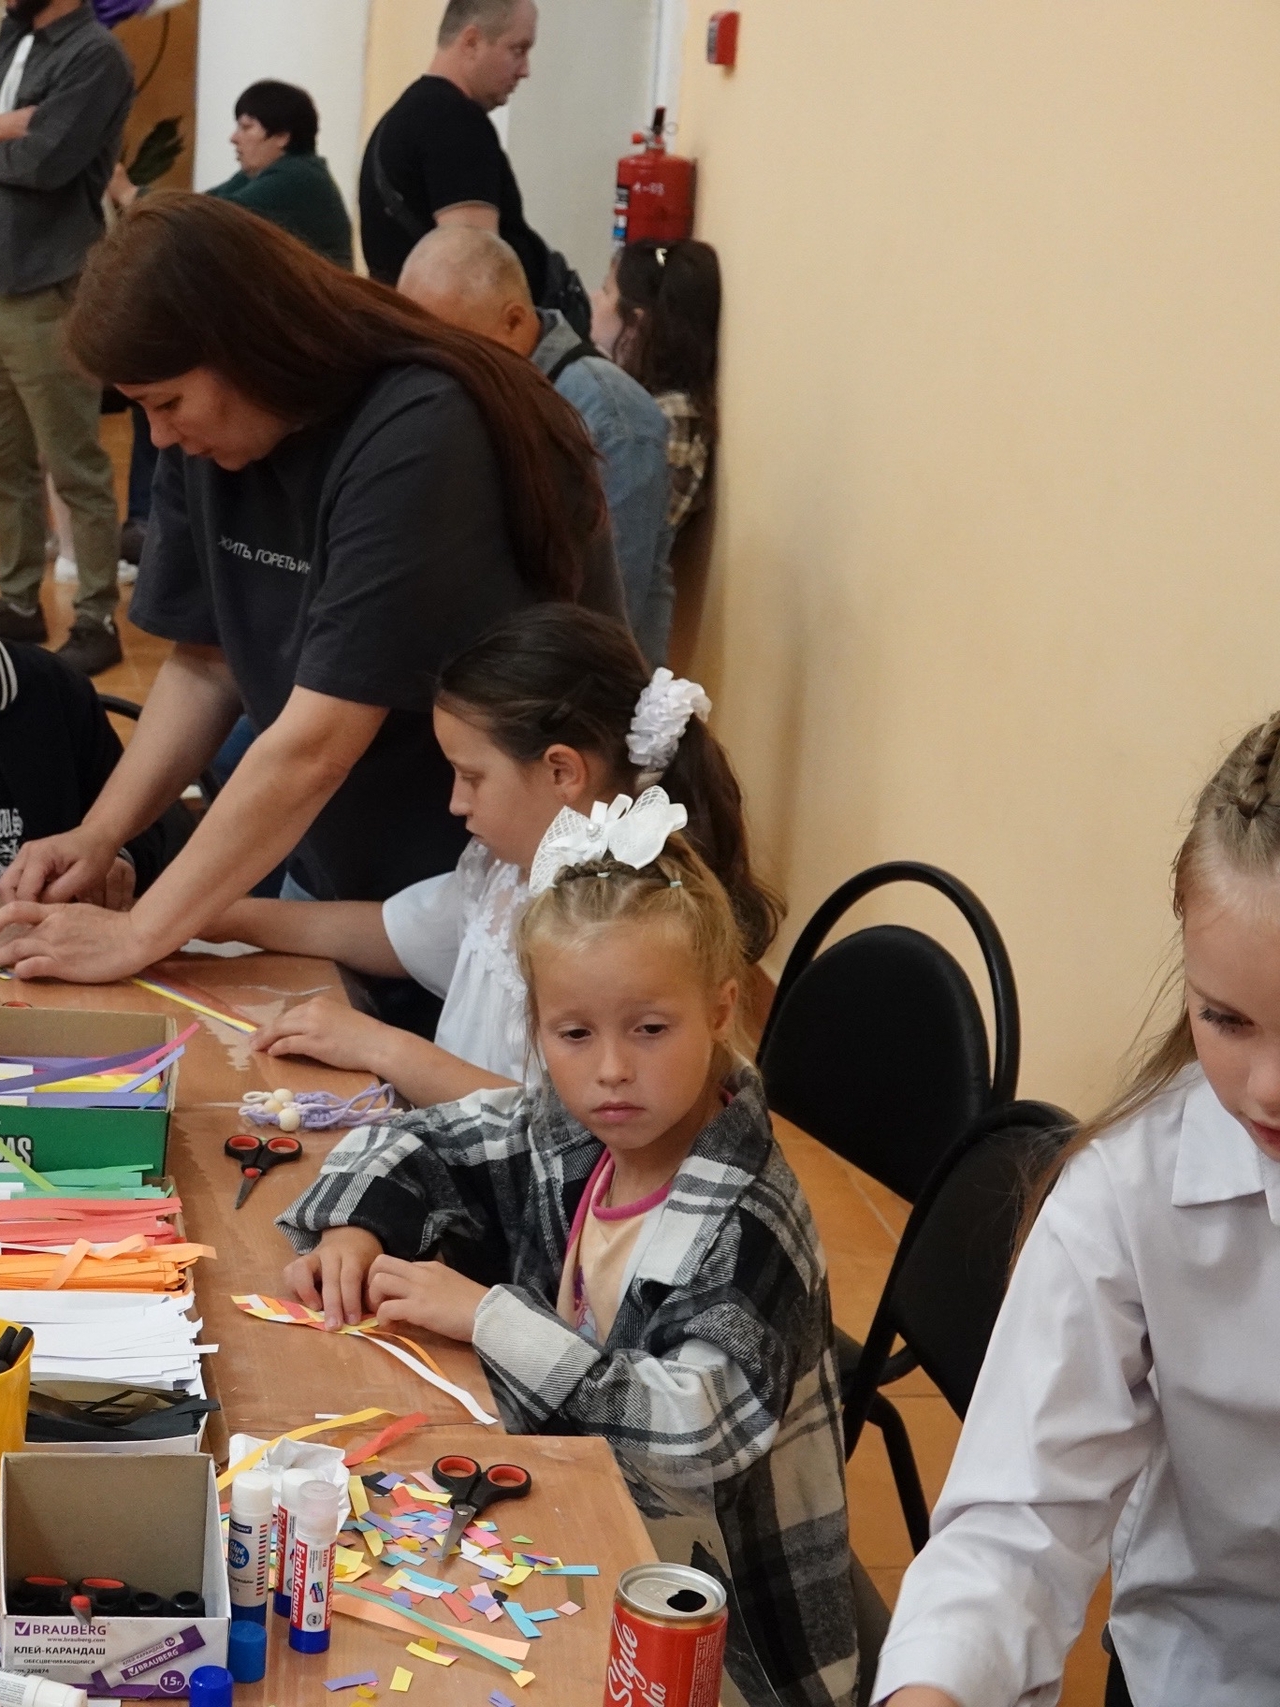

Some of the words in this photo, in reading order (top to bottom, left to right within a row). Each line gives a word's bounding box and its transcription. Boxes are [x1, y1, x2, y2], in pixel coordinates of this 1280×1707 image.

[255, 549, 297, 571] ГОРЕТЬ
[293, 1544, 306, 1623] ErichKrause
[33, 1625, 107, 1635] BRAUBERG
[14, 1645, 106, 1656] КЛЕЙ-КАРАНДАШ
[138, 1649, 179, 1672] BRAUBERG
